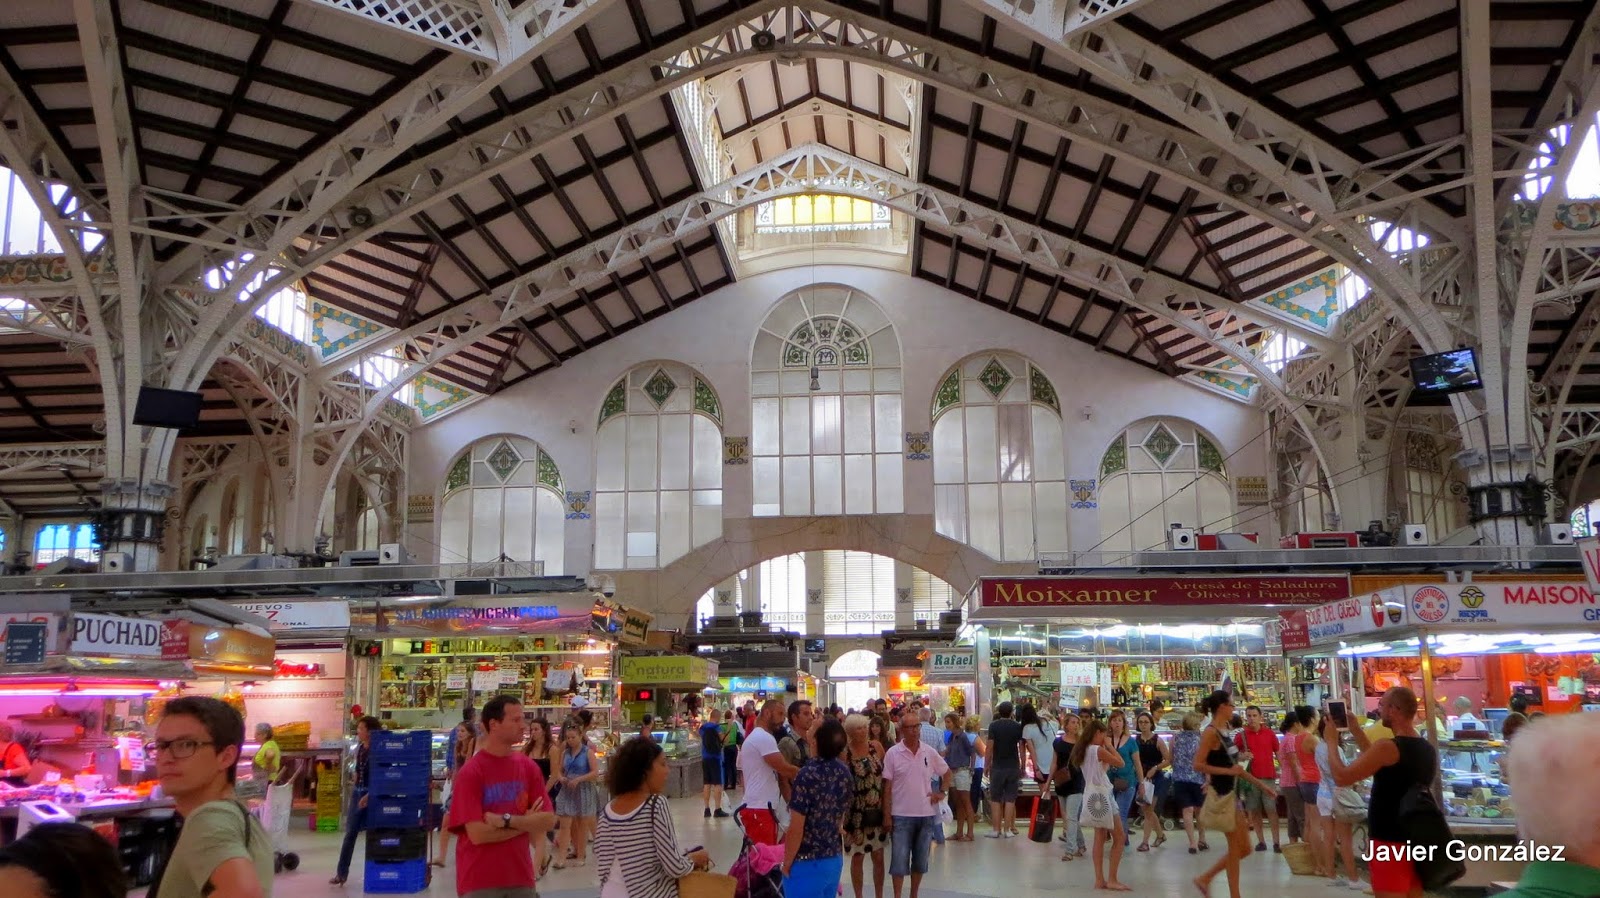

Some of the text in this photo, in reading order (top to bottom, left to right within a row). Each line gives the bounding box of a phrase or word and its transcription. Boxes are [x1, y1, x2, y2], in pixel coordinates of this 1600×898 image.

[1232, 581, 1251, 590] de
[1259, 580, 1338, 590] Saladura
[993, 583, 1158, 603] Moixamer
[1187, 591, 1240, 599] Olives
[1259, 590, 1321, 598] Fumats
[1503, 585, 1596, 605] MAISON
[934, 654, 973, 665] Rafael
[636, 663, 685, 676] natura
